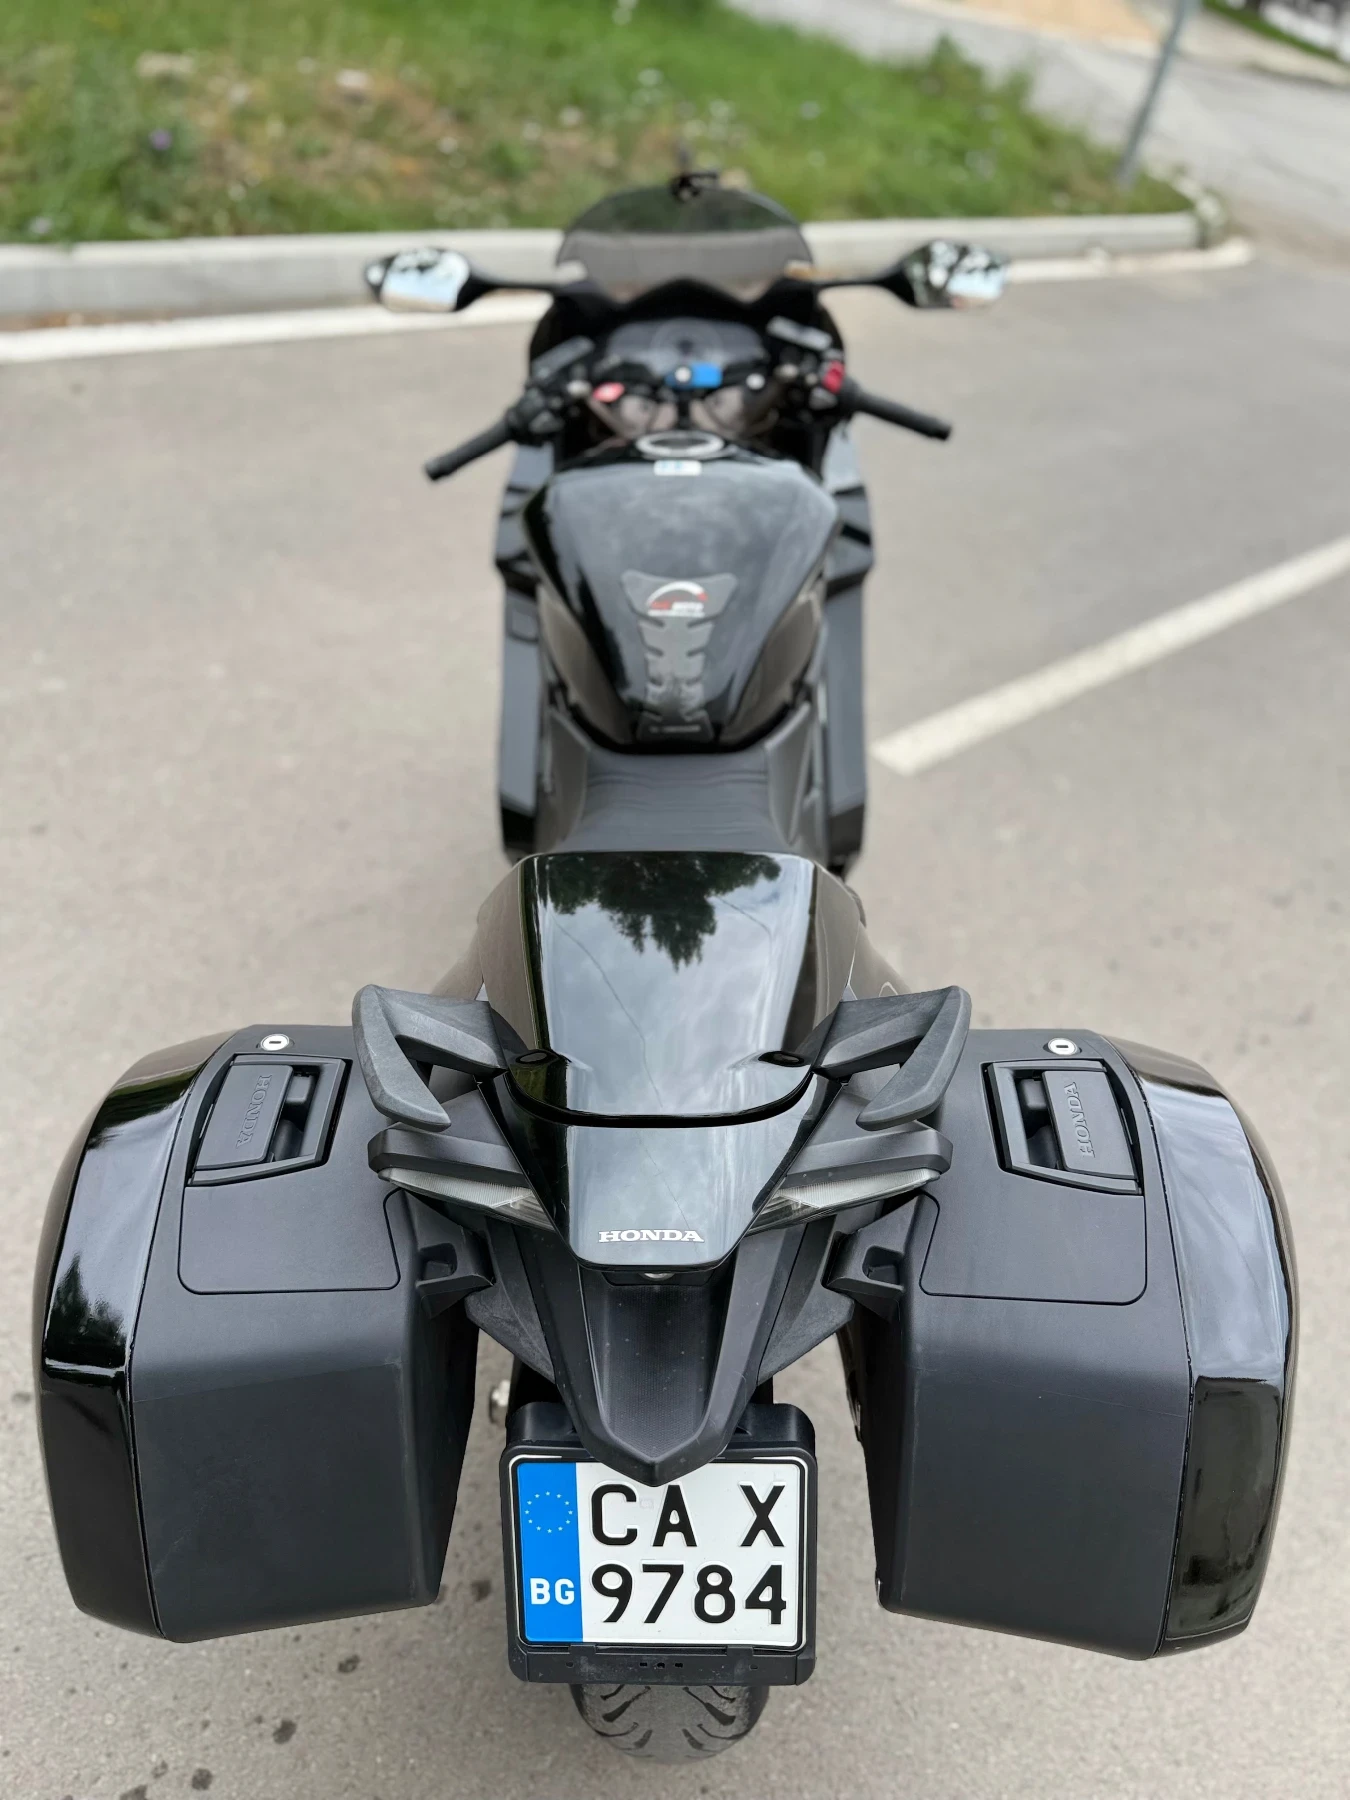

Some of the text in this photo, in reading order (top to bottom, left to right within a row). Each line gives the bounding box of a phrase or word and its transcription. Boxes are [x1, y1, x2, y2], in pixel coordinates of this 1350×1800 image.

[236, 1074, 273, 1148] HONDA
[1063, 1081, 1096, 1158] HONDA
[598, 1229, 705, 1243] HONDA
[591, 1483, 786, 1547] CA X
[529, 1578, 575, 1605] BG
[591, 1563, 787, 1625] 9784
